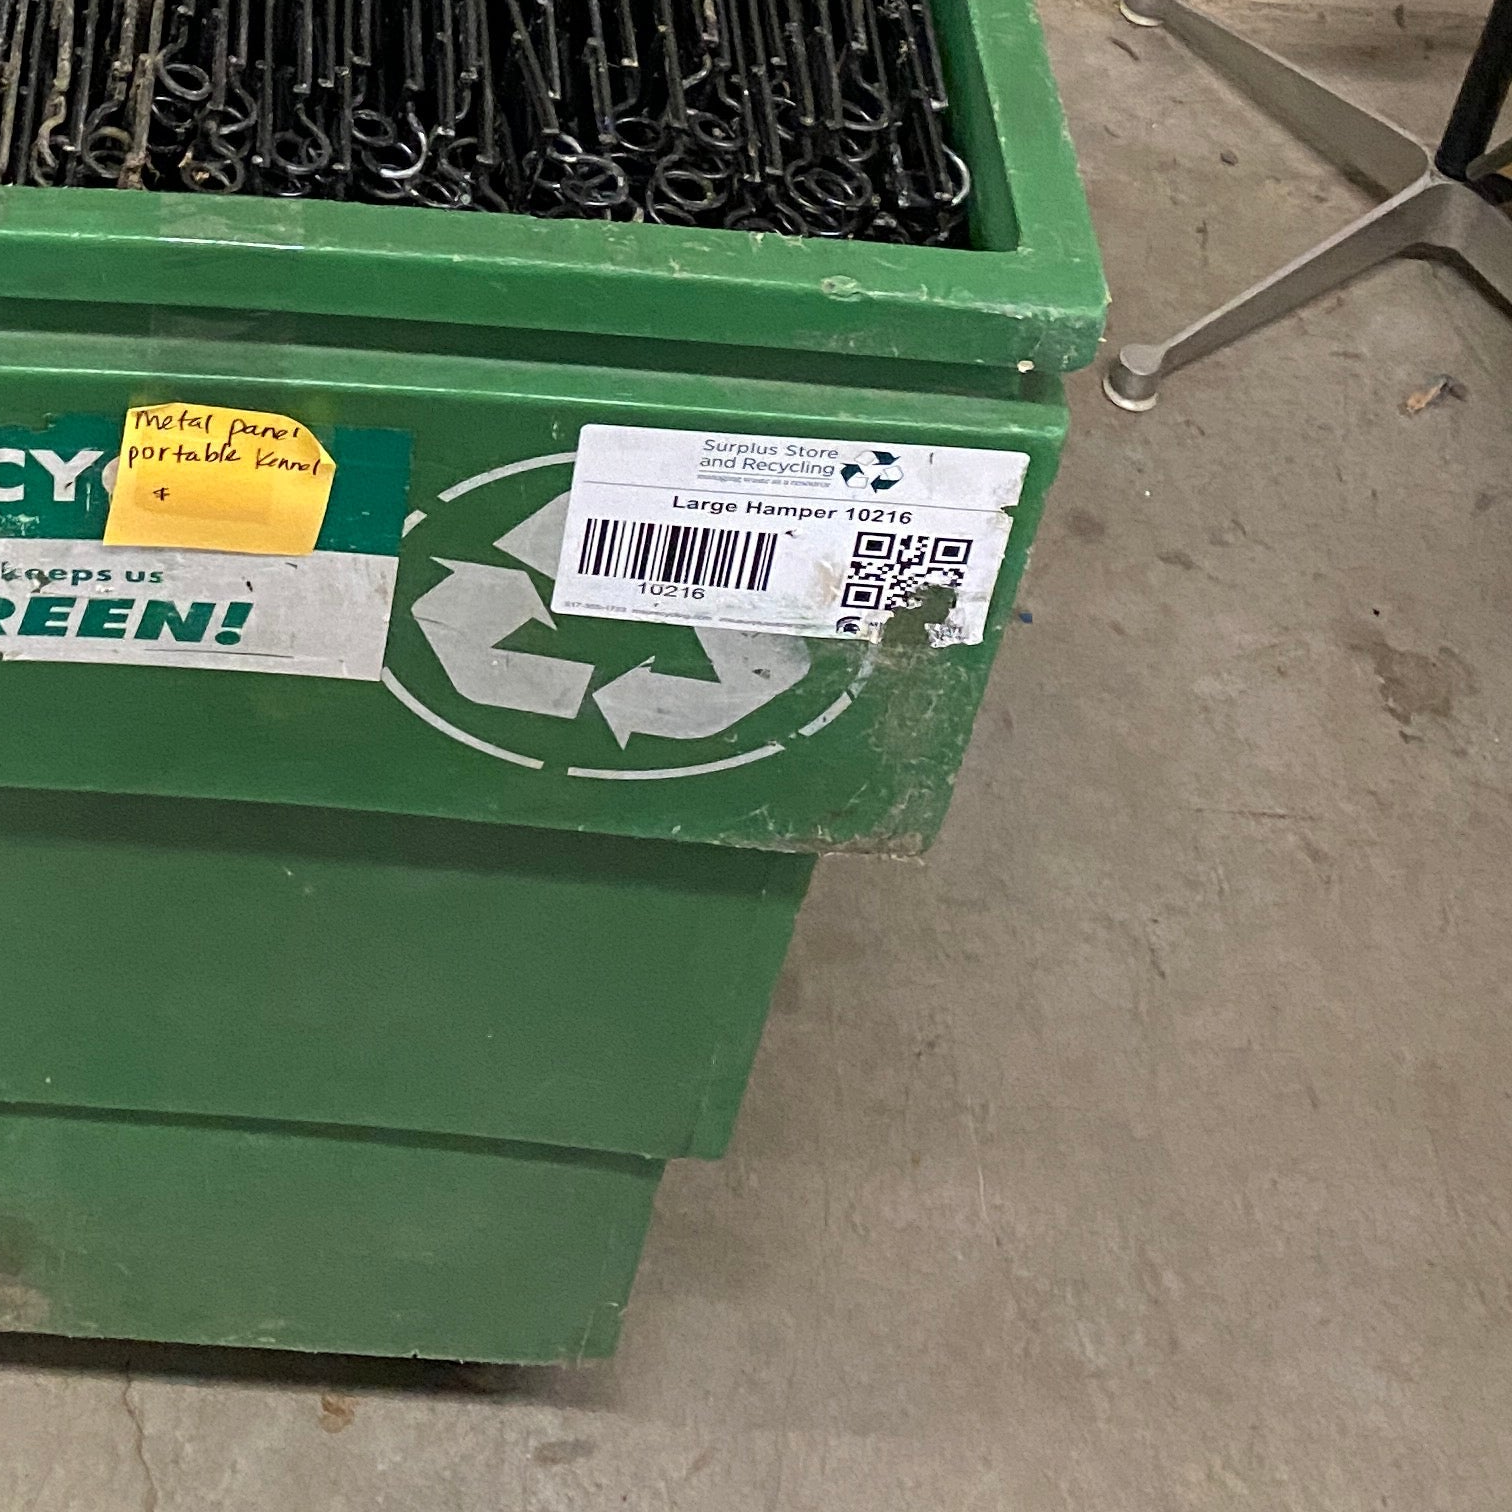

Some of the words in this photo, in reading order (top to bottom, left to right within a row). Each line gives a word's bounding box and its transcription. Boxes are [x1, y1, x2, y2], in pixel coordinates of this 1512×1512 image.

[129, 442, 241, 469] portable
[702, 439, 778, 456] Surplus
[785, 444, 839, 460] Store
[699, 455, 736, 469] and
[742, 458, 835, 477] Recycling
[672, 495, 738, 514] Large
[746, 501, 838, 520] Hamper
[846, 507, 913, 525] 10216
[125, 570, 164, 584] us
[639, 582, 706, 600] 10216
